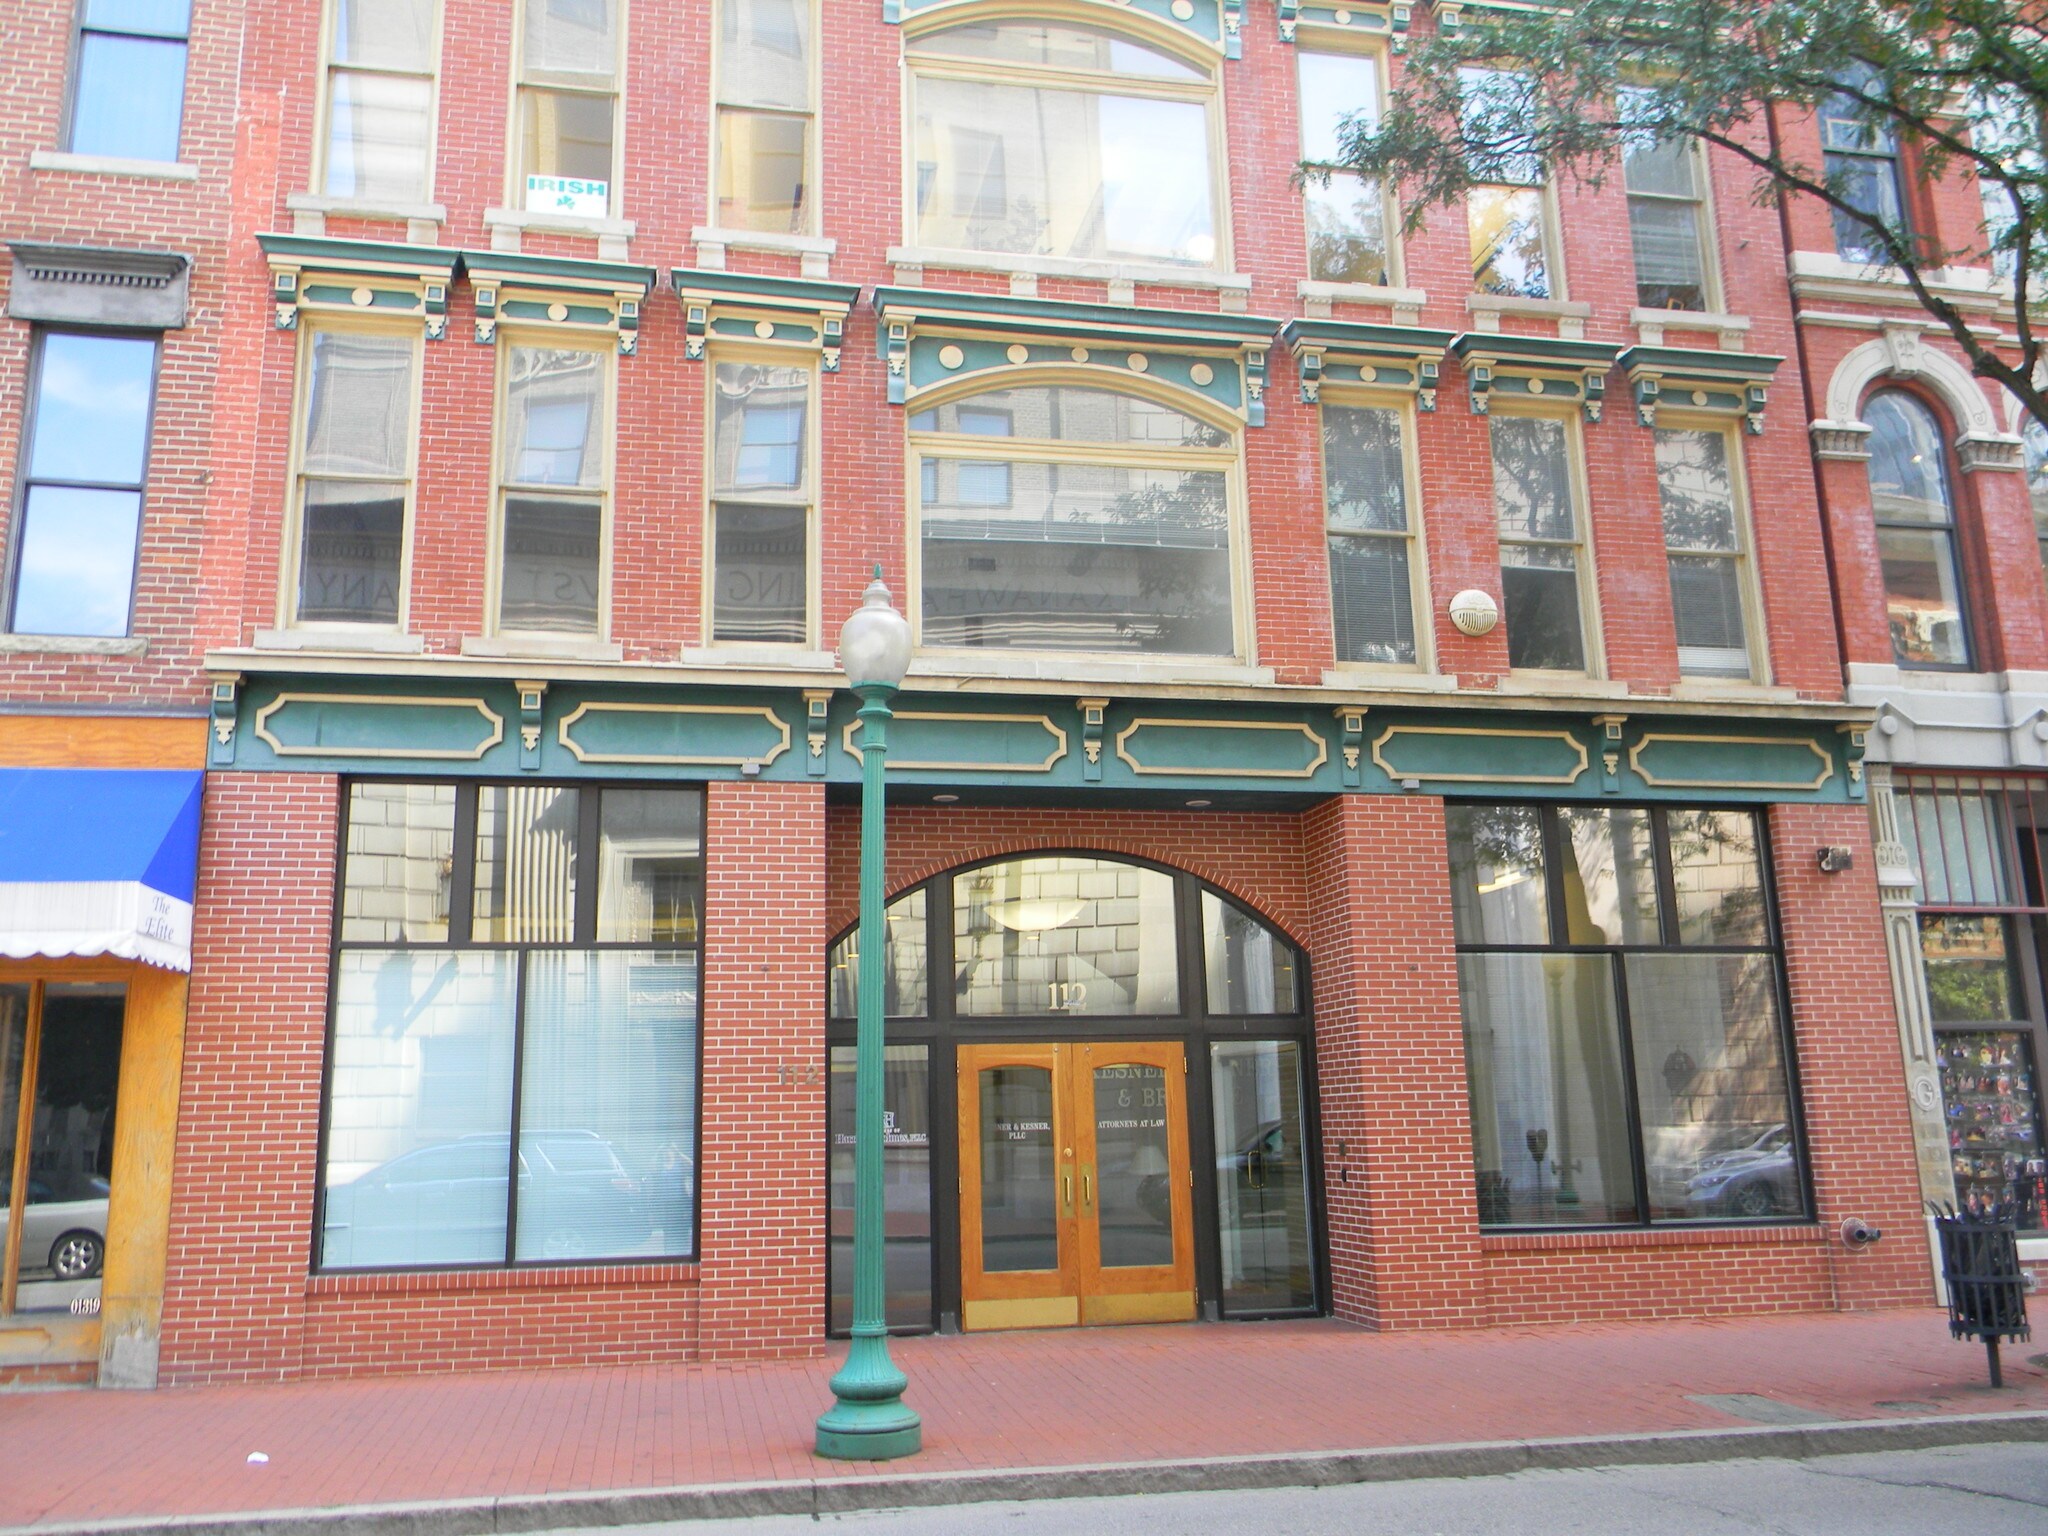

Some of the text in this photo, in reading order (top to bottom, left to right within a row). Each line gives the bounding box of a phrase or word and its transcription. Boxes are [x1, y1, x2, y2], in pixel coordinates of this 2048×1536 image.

[528, 177, 605, 197] IRISH
[152, 896, 171, 915] The
[145, 917, 174, 941] Elite
[1048, 982, 1087, 1010] 112
[777, 1065, 819, 1085] 112
[1118, 1088, 1131, 1107] &
[1013, 1123, 1019, 1131] &
[1020, 1122, 1051, 1131] KESNER,
[1098, 1119, 1165, 1129] ATTORNEYS AT LAW
[1008, 1131, 1026, 1140] PLLC
